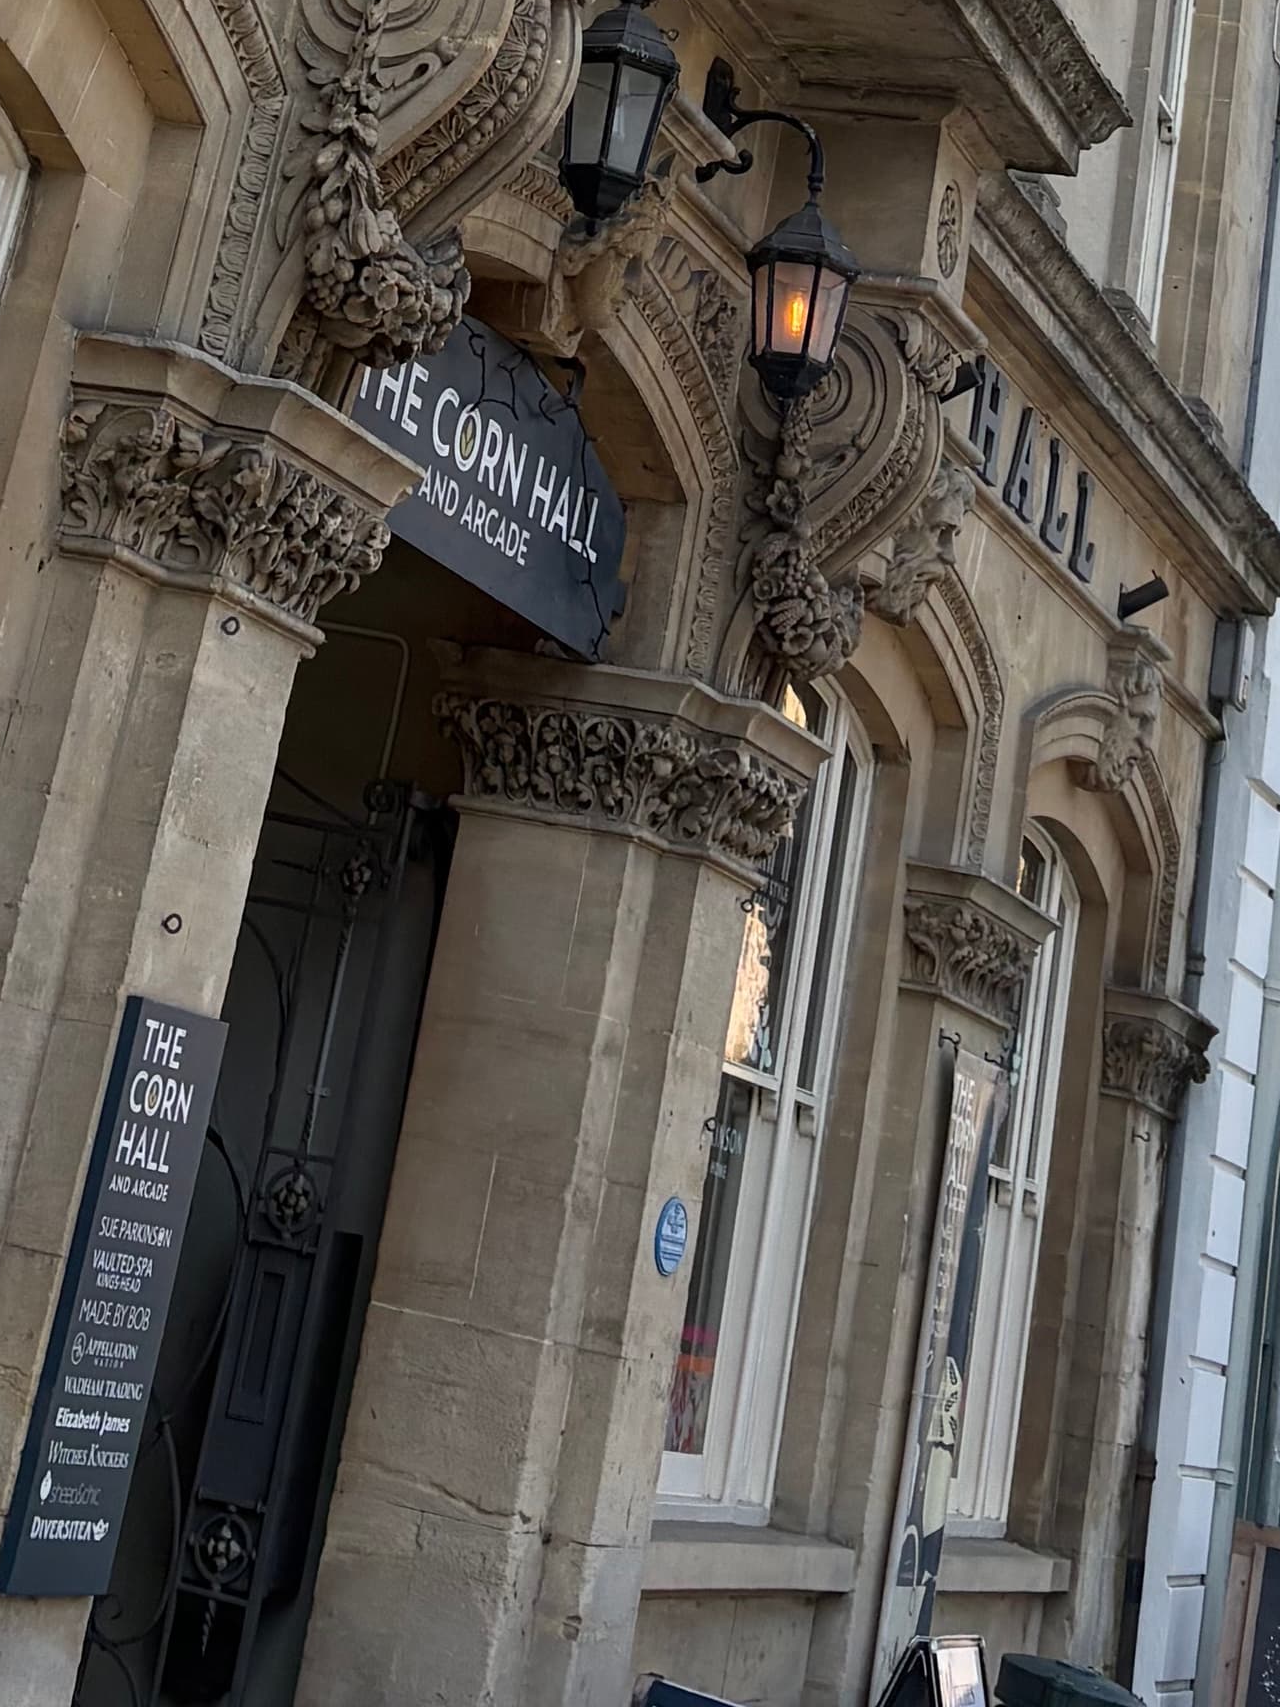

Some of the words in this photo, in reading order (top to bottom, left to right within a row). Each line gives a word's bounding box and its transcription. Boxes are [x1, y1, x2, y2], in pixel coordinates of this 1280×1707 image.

[432, 387, 528, 508] CORN
[528, 455, 599, 564] HALL
[969, 354, 1096, 585] HALL
[418, 464, 460, 517] AND
[460, 494, 531, 567] ARCADE
[143, 1018, 187, 1069] THE
[129, 1070, 194, 1124] CORN
[115, 1120, 170, 1173] HALL
[108, 1174, 131, 1195] AND
[131, 1178, 169, 1203] ARCADE
[99, 1216, 120, 1239] SUE
[119, 1220, 173, 1248] PARKINSON
[78, 1298, 113, 1326] MADE
[112, 1303, 129, 1327] BY
[127, 1305, 151, 1332] BOB
[55, 1406, 101, 1430] Elizabeth
[99, 1410, 131, 1436] James
[30, 1515, 91, 1541] DIVERSITEA
